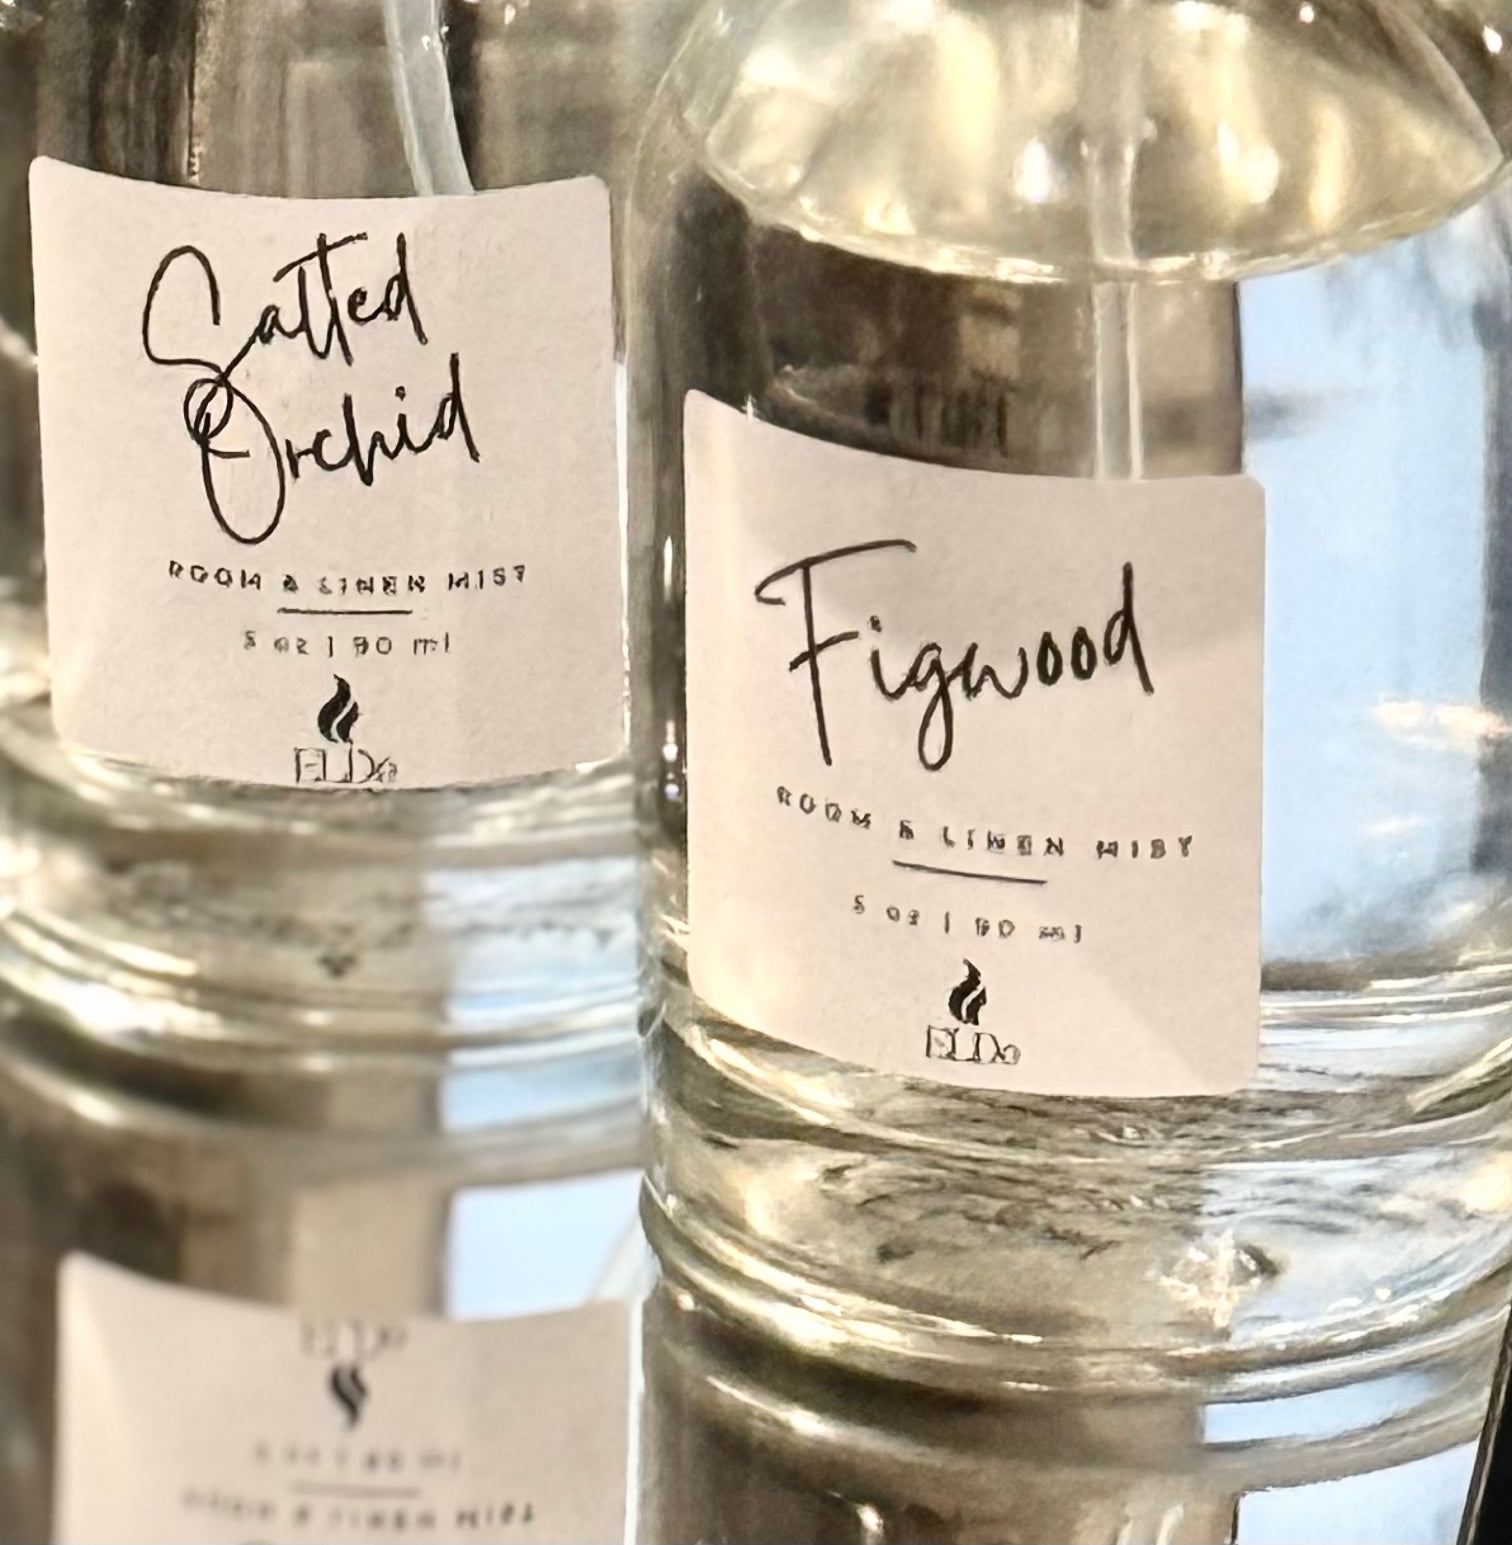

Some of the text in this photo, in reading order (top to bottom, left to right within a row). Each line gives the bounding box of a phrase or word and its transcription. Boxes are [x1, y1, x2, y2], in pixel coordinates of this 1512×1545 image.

[141, 231, 430, 444] Salted
[192, 351, 481, 547] Orchid
[167, 559, 263, 591] ROOM
[752, 538, 1155, 774] Figwood
